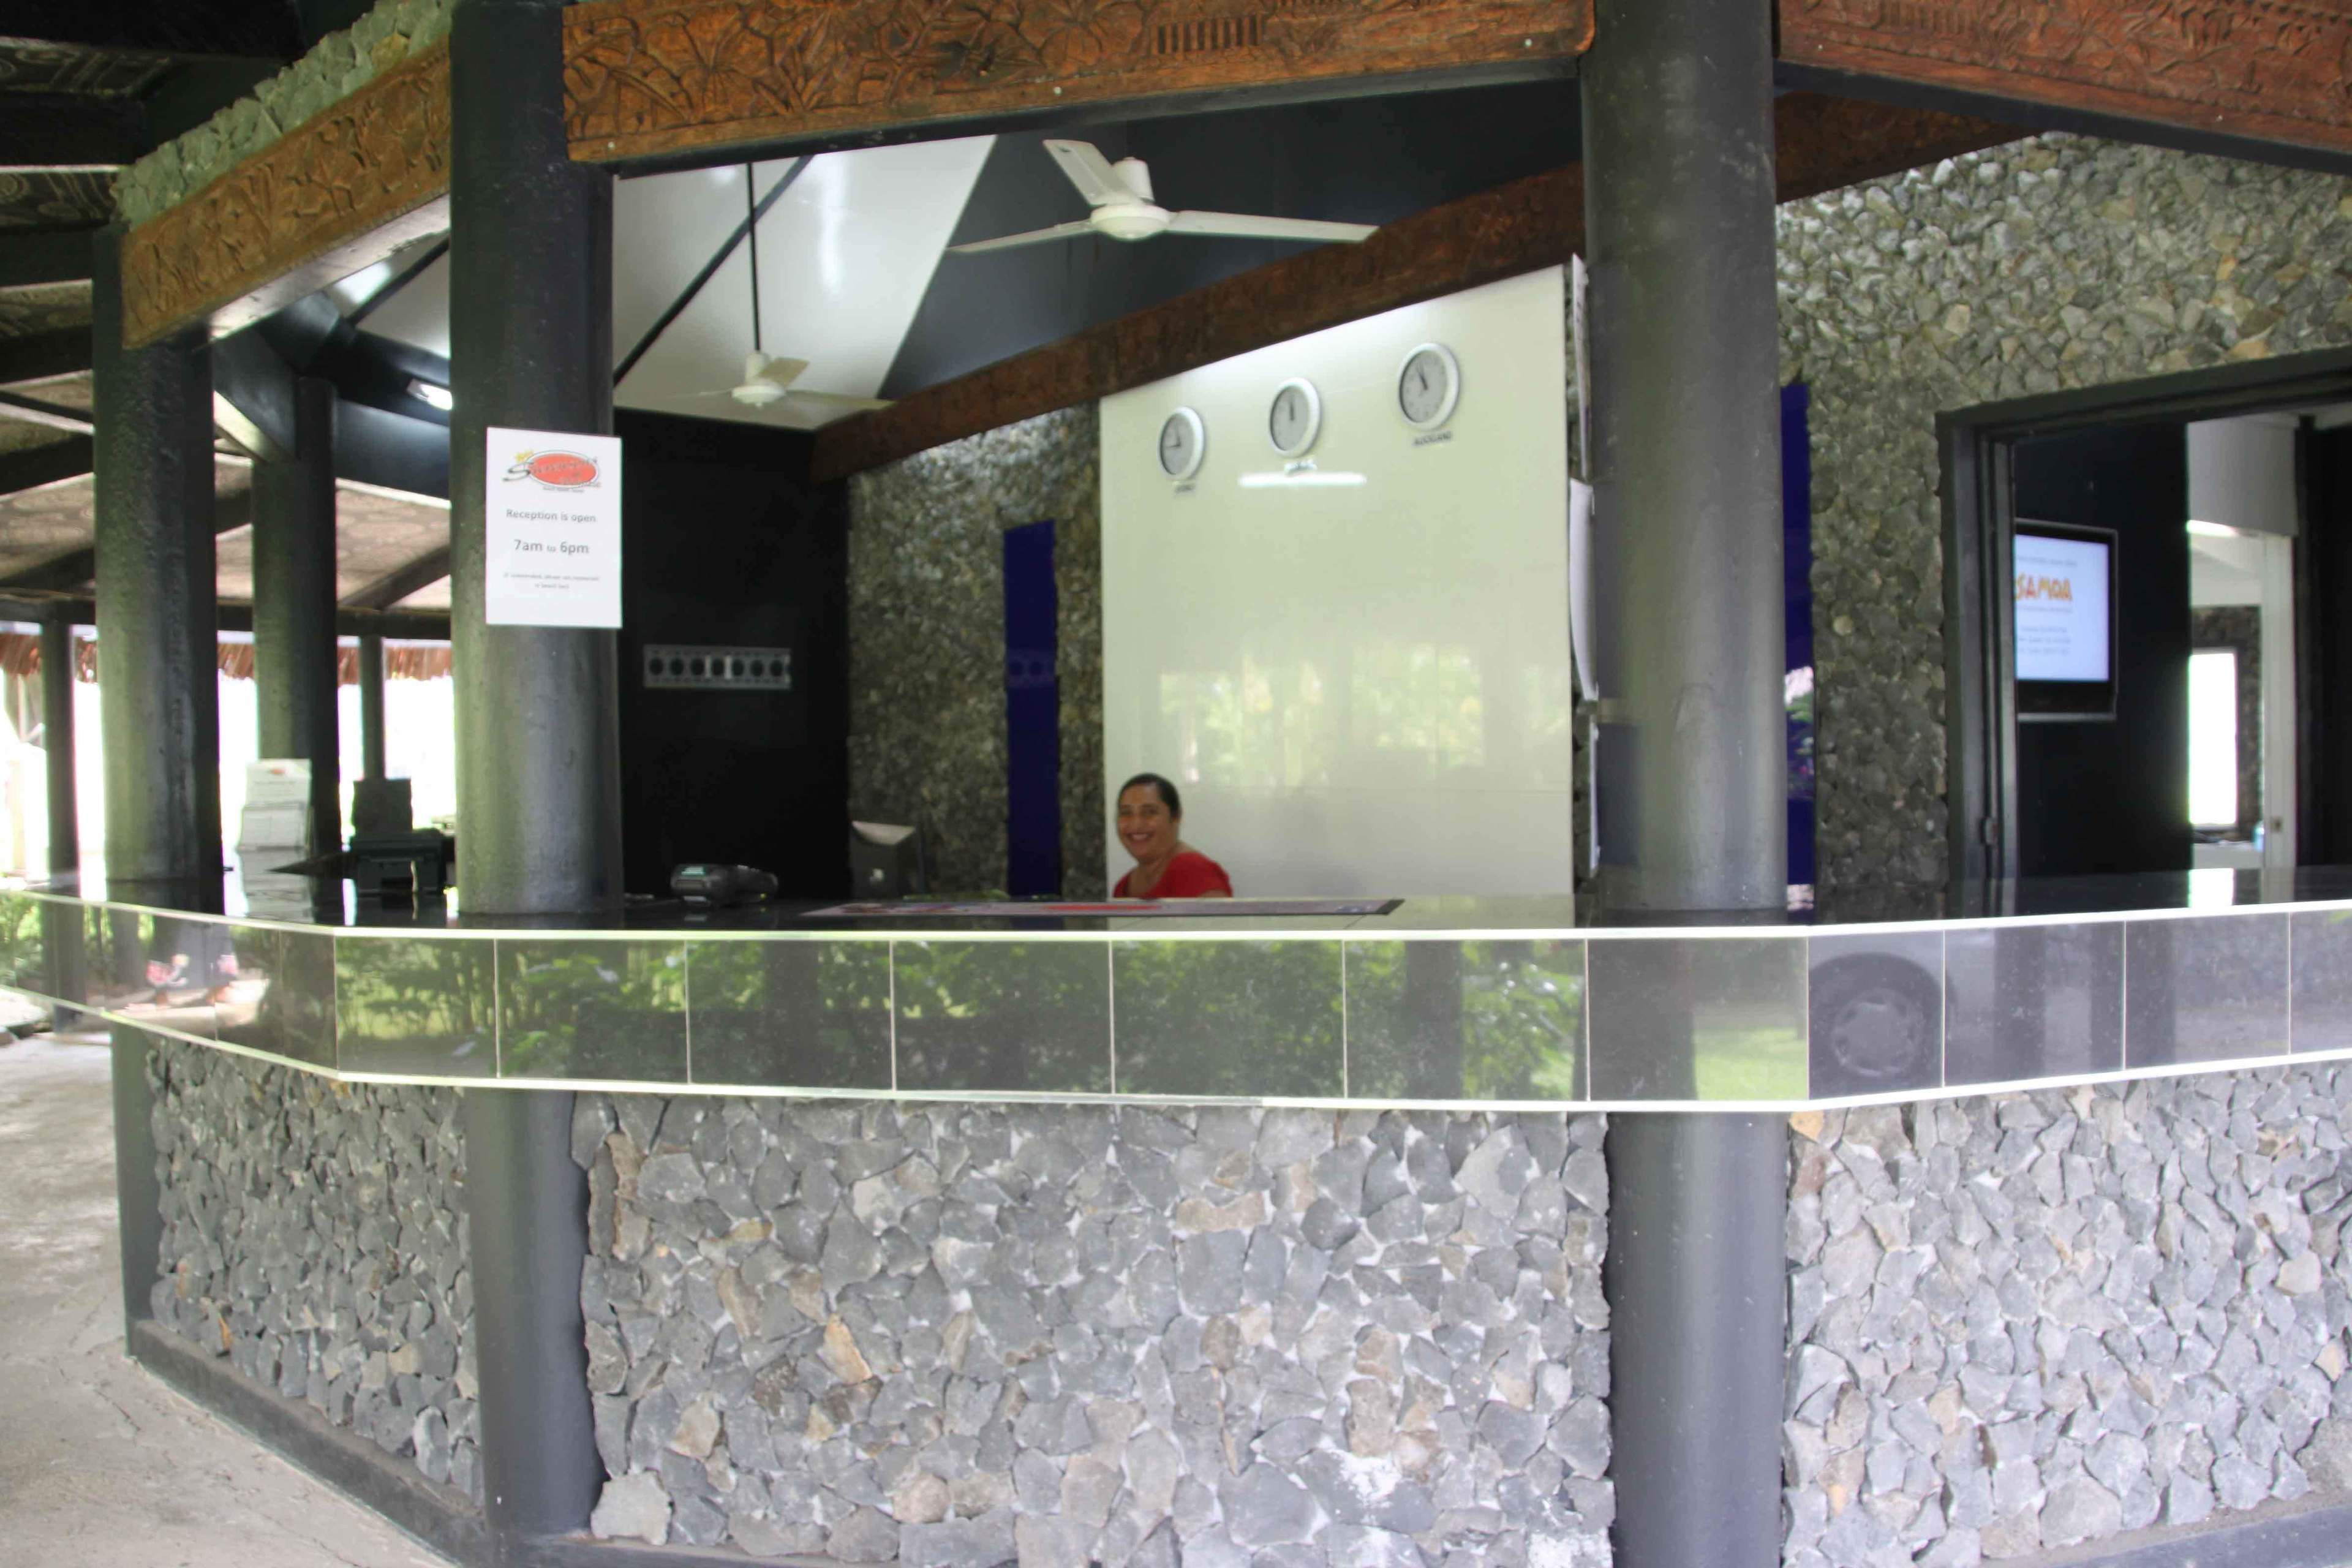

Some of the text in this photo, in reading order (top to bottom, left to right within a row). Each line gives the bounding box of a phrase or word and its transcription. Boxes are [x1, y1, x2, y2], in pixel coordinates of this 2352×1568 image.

[506, 509, 597, 523] Reception is open
[514, 539, 543, 551] 7am
[560, 541, 589, 555] 6pm
[2016, 573, 2071, 600] SAMOA
